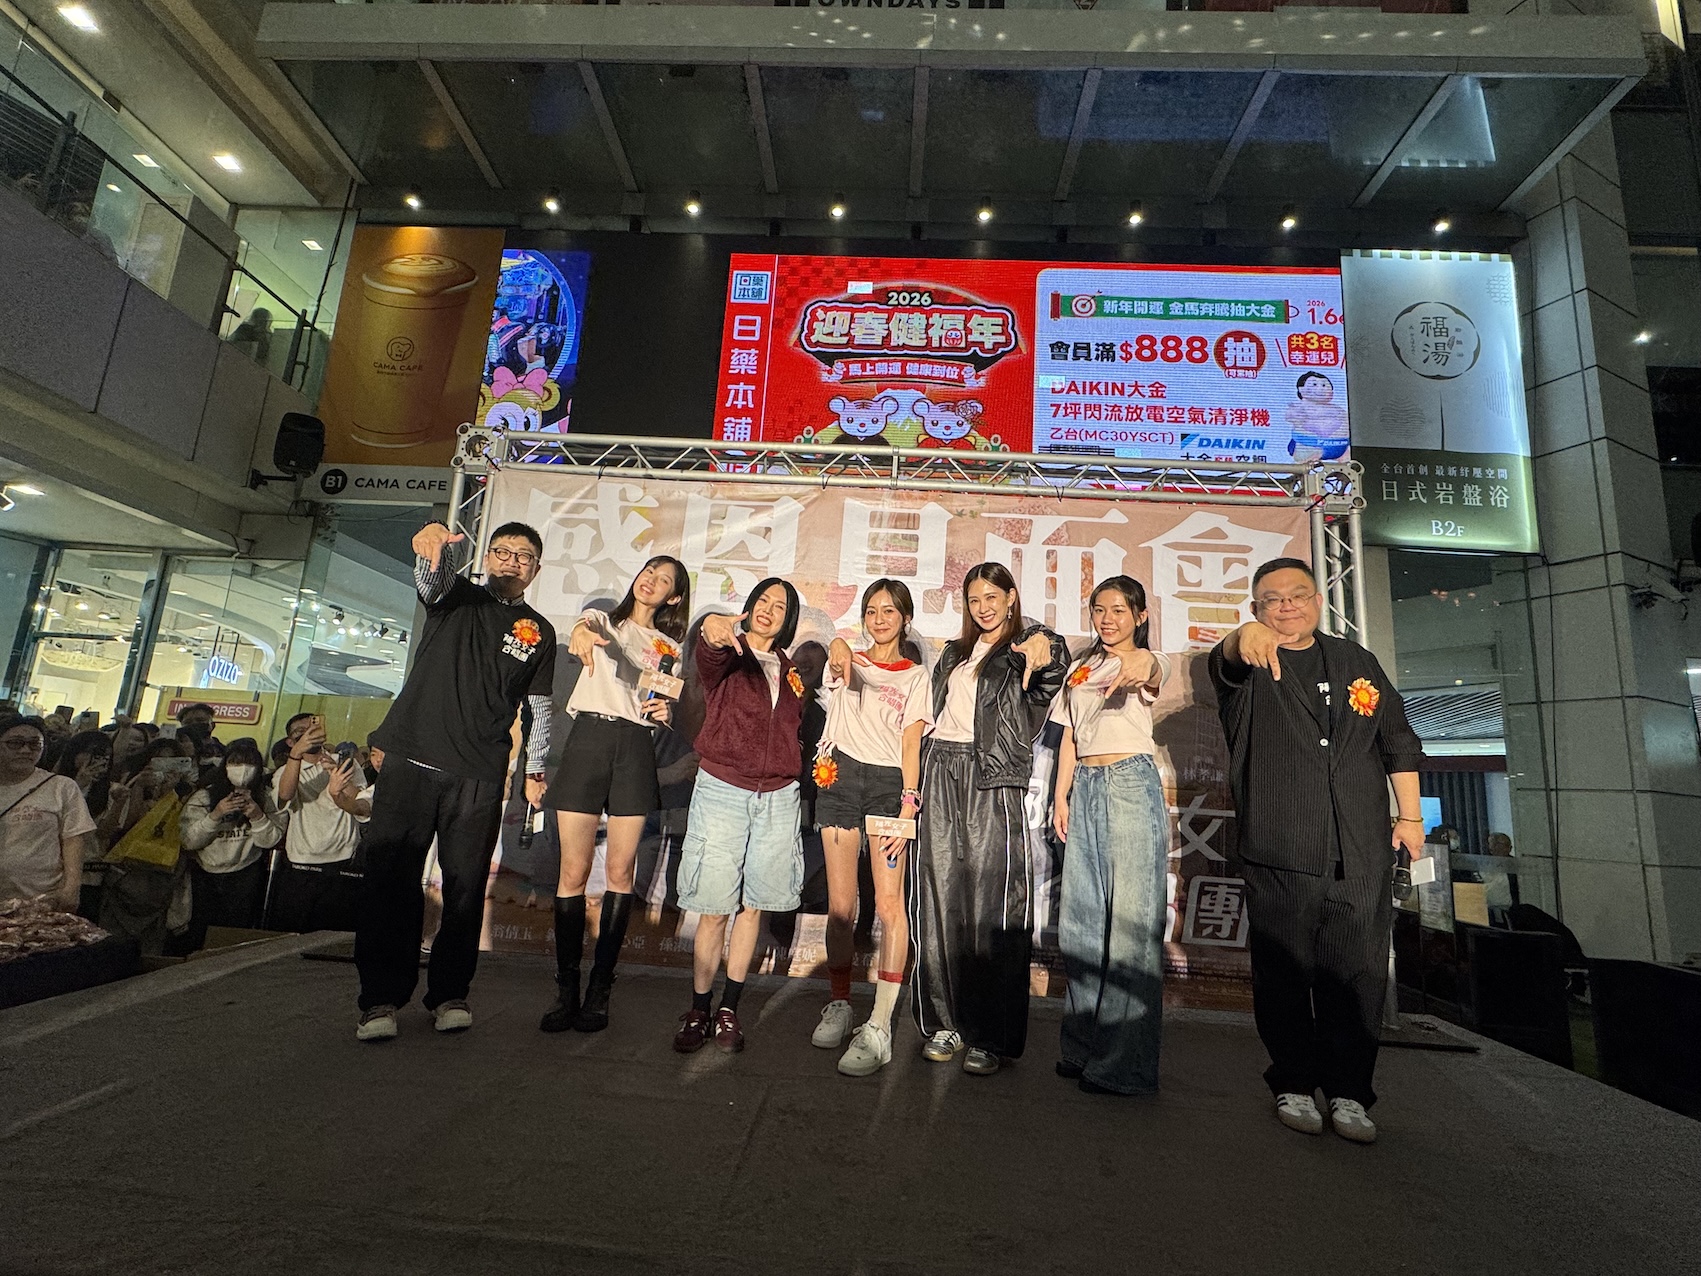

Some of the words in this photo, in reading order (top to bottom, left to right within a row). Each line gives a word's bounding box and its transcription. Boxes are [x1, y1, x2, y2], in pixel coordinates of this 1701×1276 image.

[888, 292, 932, 306] 2026
[1103, 300, 1164, 315] 新年開運
[1169, 301, 1276, 318] 金馬奔騰抽大金
[811, 309, 1007, 349] 迎春健福年
[1290, 333, 1335, 349] 共3名
[1420, 316, 1451, 366] 福湯
[1224, 337, 1258, 367] 抽
[1290, 351, 1336, 365] 幸運兒
[722, 315, 762, 442] 日藥本舖
[1050, 403, 1271, 427] 7坪閃流放電空氣清淨機
[1198, 438, 1266, 450] DAIKIN
[1381, 463, 1429, 476] 全台首創
[1435, 465, 1508, 480] 最新紓壓空間
[324, 476, 343, 488] B1
[354, 477, 400, 489] CAMA
[406, 479, 448, 491] CAFE
[1382, 480, 1510, 508] 日式岩盤浴
[1431, 520, 1465, 536] B2F
[522, 482, 1294, 655] 感恩見面會
